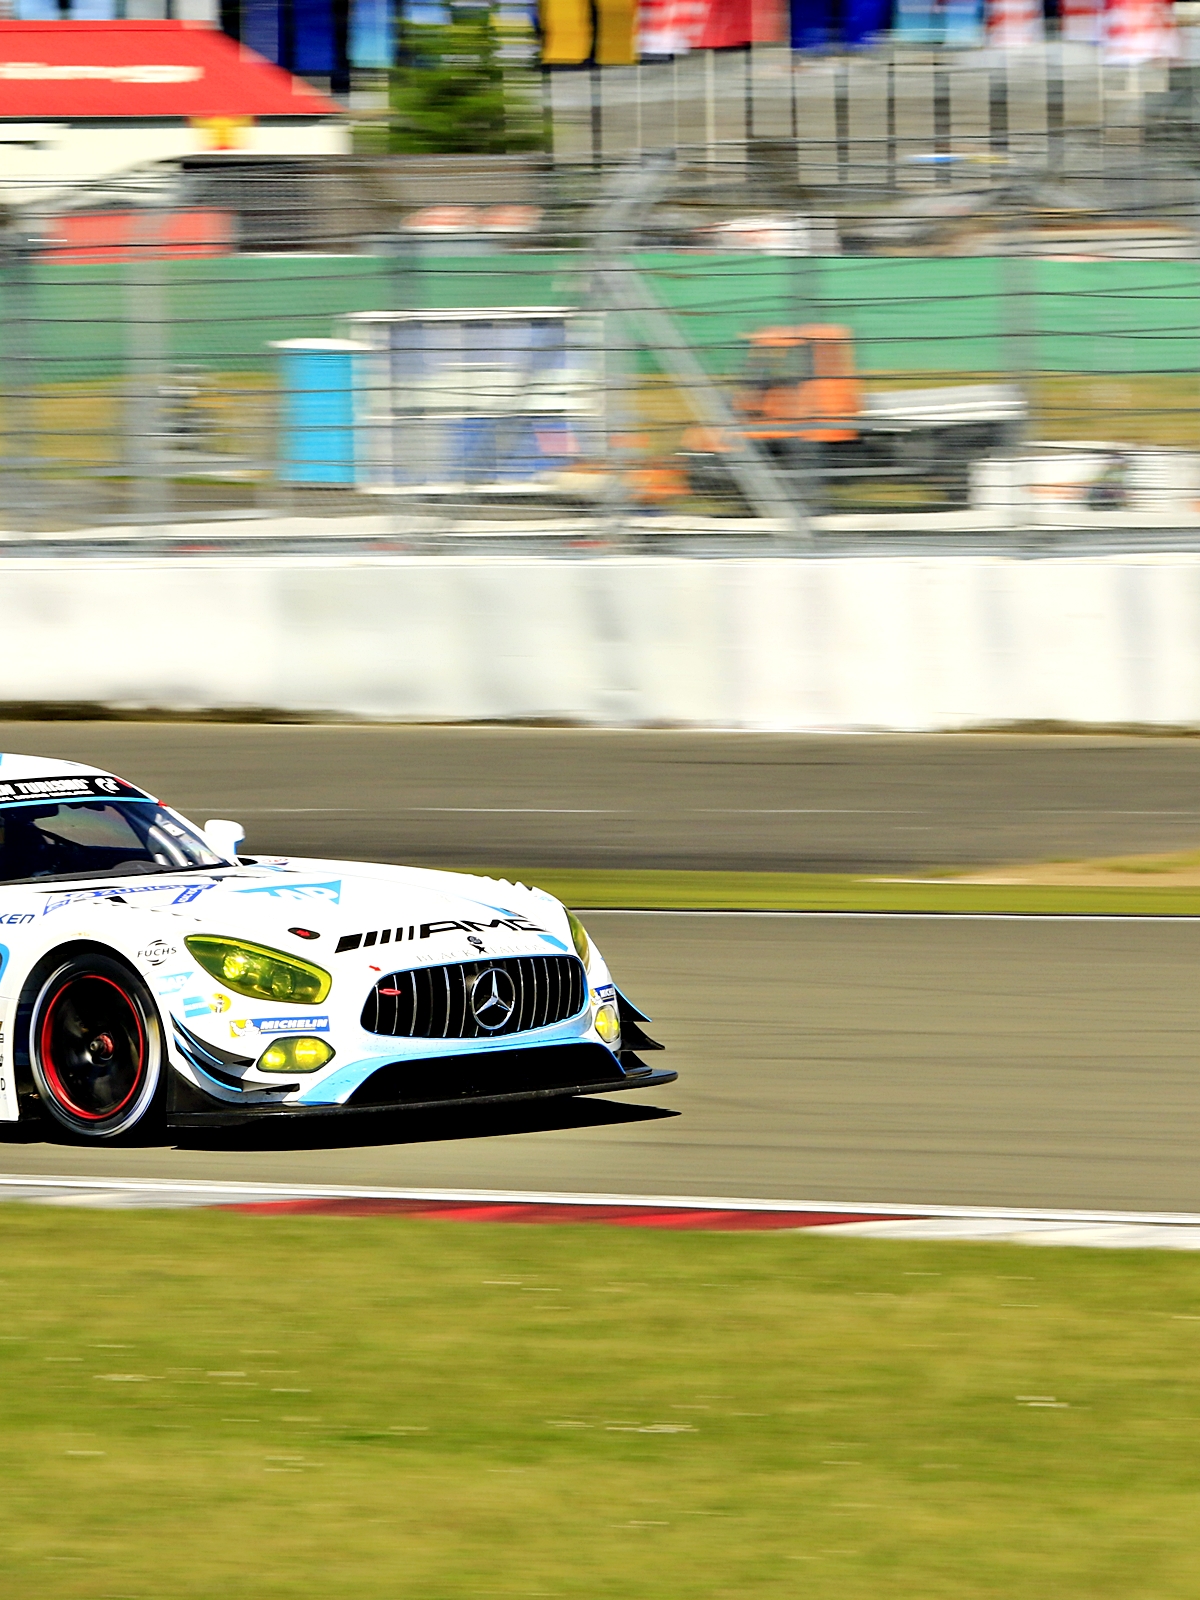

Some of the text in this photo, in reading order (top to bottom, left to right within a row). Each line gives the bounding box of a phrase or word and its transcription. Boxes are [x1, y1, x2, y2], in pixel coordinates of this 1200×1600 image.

[14, 779, 89, 794] TURISMO
[137, 947, 177, 958] FUCHS
[261, 1018, 328, 1030] MICHELIN
